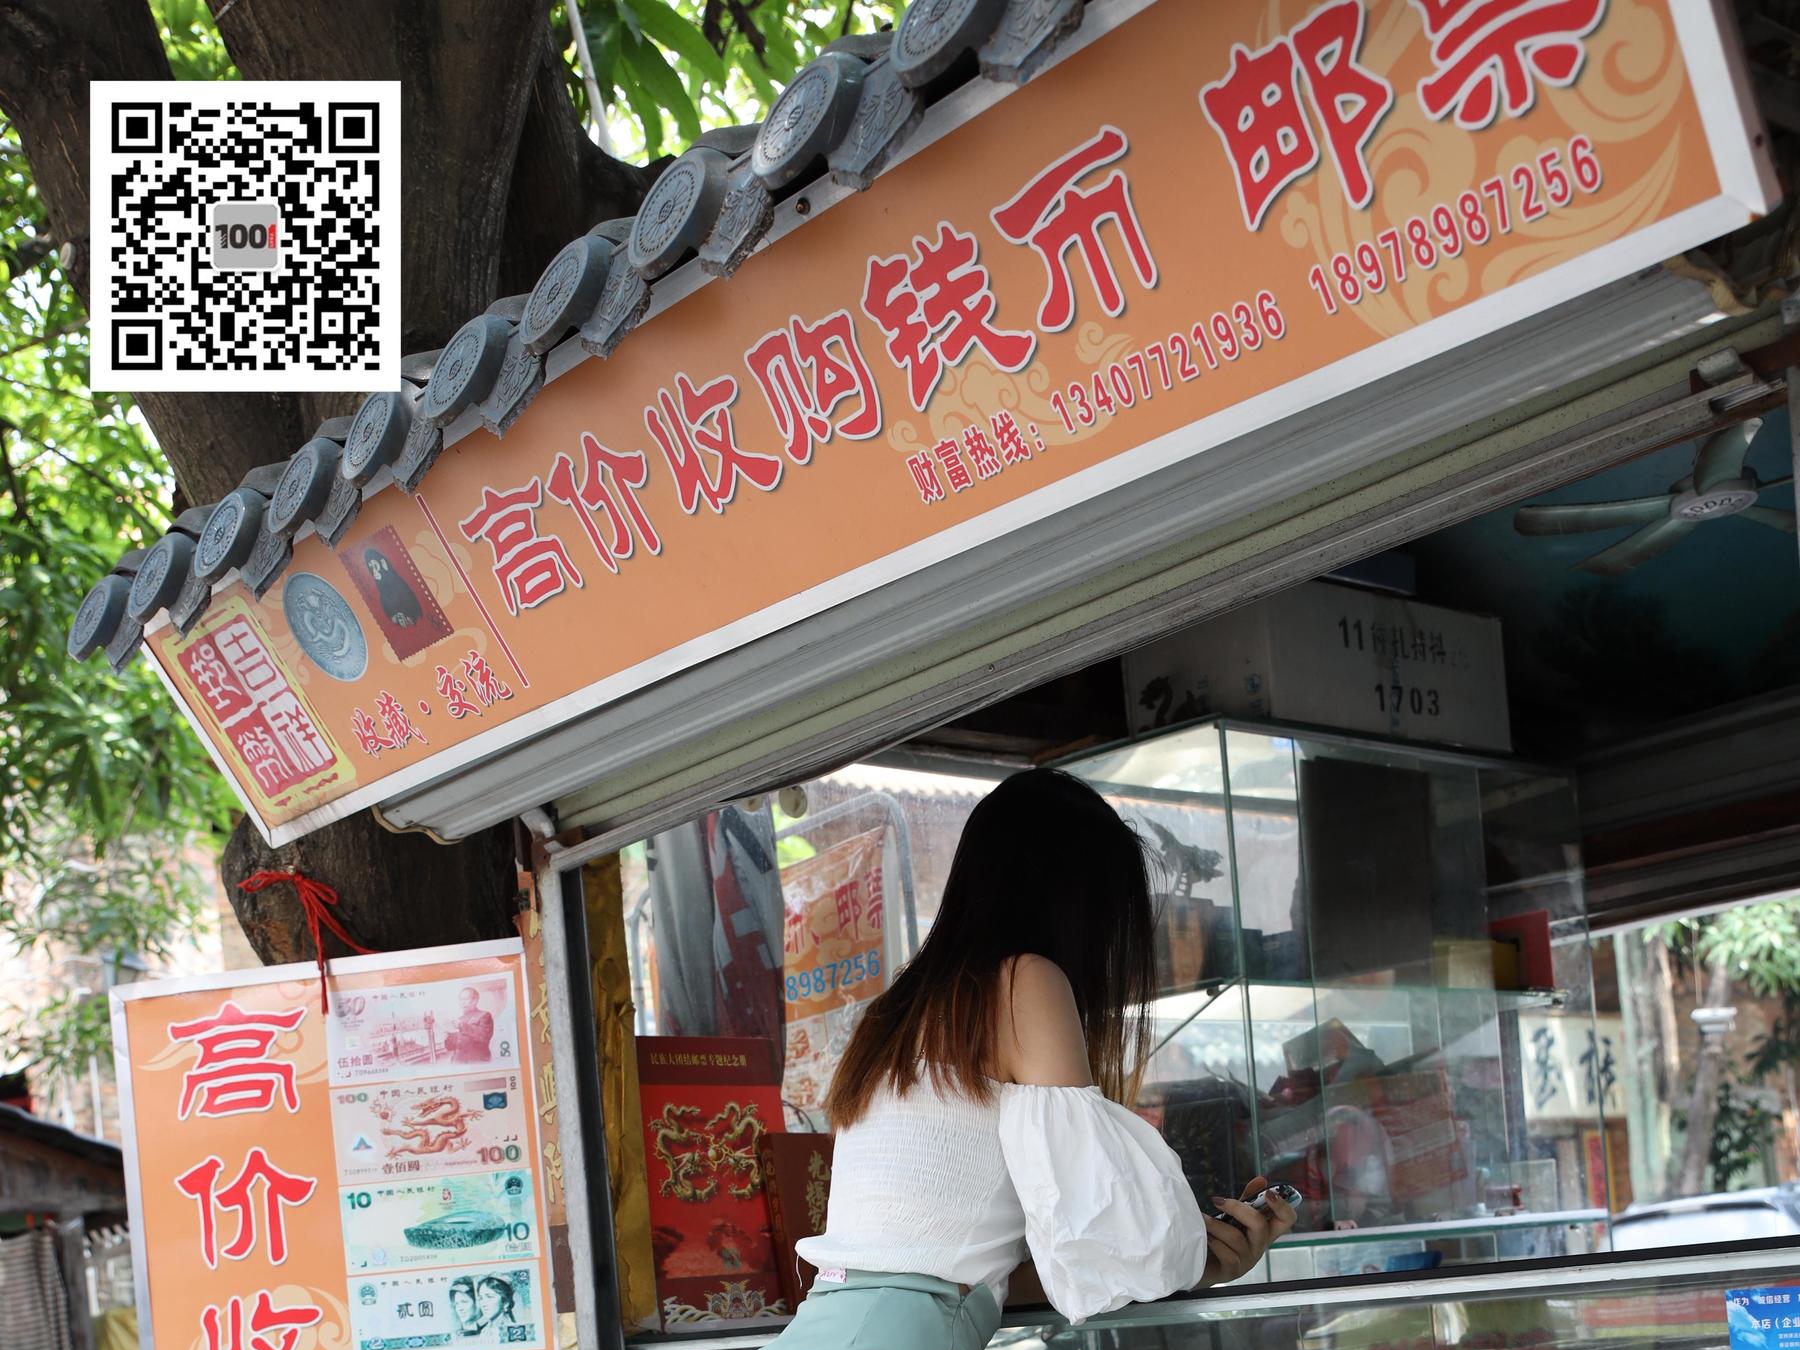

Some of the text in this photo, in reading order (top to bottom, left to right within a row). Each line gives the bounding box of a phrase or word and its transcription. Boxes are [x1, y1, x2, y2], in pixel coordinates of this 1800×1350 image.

[1050, 290, 1287, 434] 13407721936
[1307, 134, 1602, 315] 18978987256
[459, 124, 1159, 615] 高价收购钱币
[1375, 683, 1440, 716] 1703
[785, 949, 881, 1001] 8987256
[477, 1144, 521, 1165] 100
[347, 1191, 372, 1210] 10
[503, 1222, 530, 1242] 10
